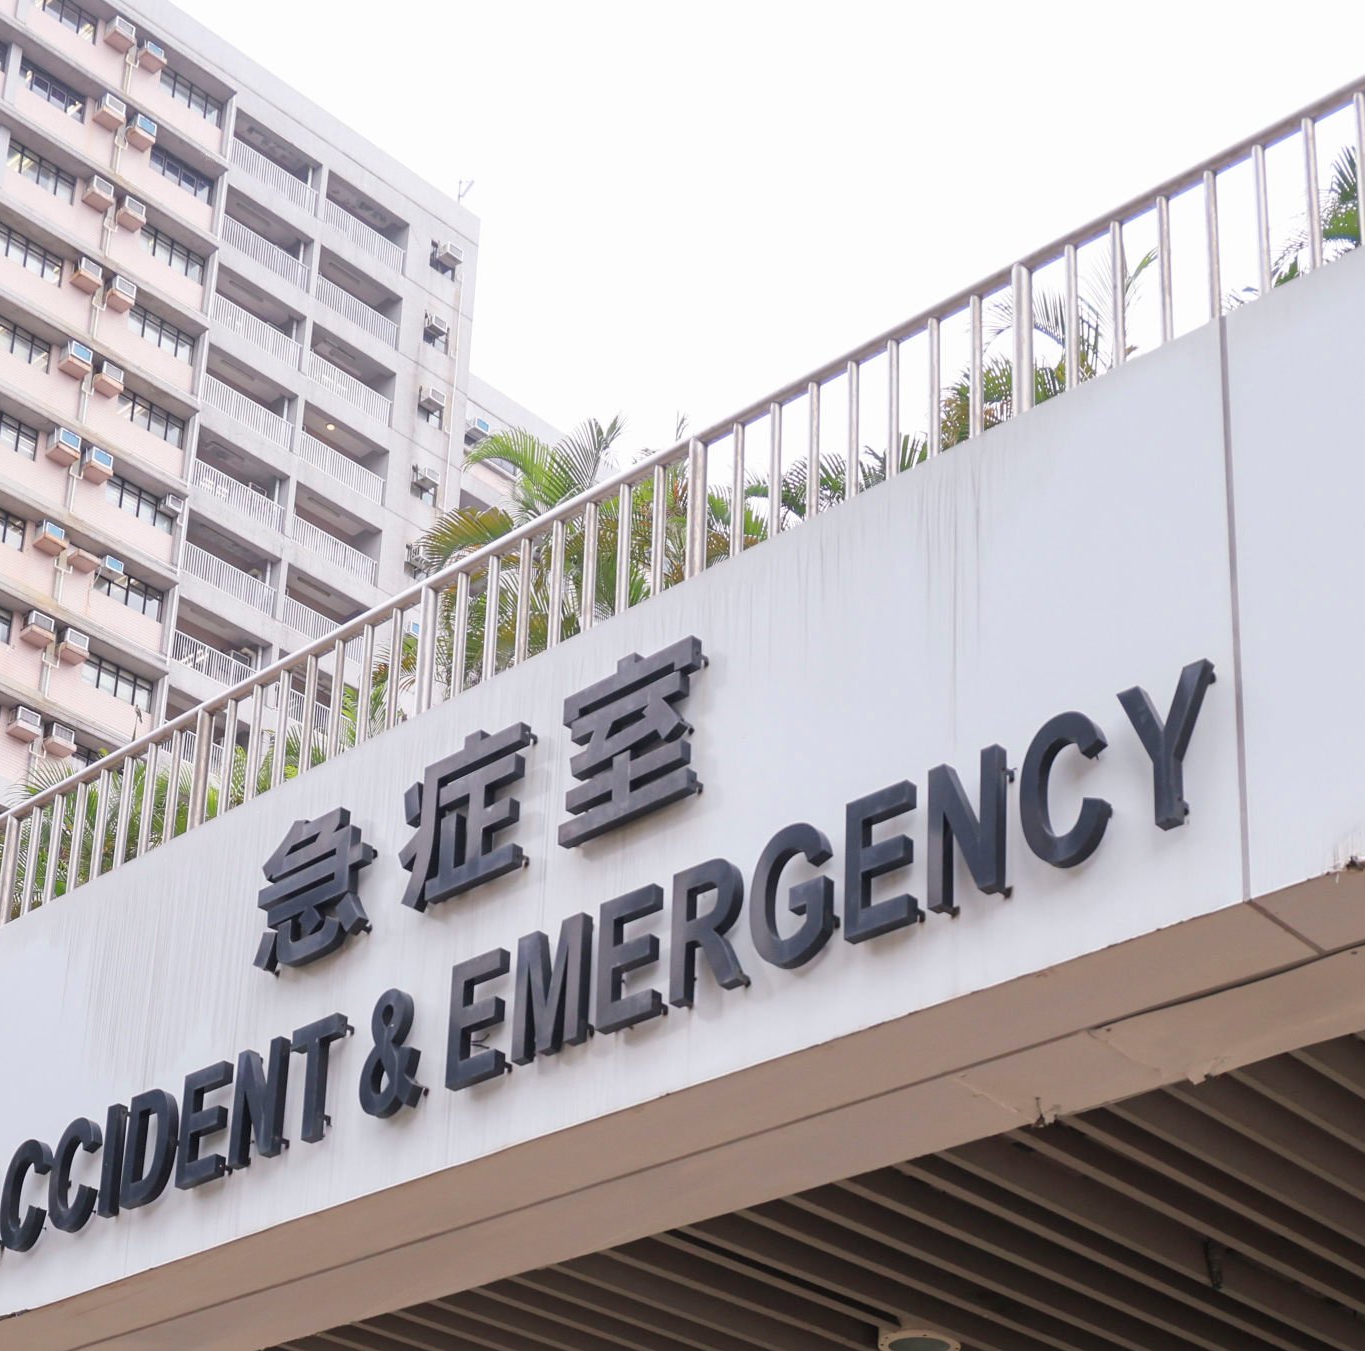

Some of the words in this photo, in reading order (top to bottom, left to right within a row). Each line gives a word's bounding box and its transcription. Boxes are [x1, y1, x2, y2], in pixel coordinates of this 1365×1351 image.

[253, 635, 709, 978] 急症室
[358, 988, 428, 1119] &
[445, 657, 1216, 1092] EMERGENCY
